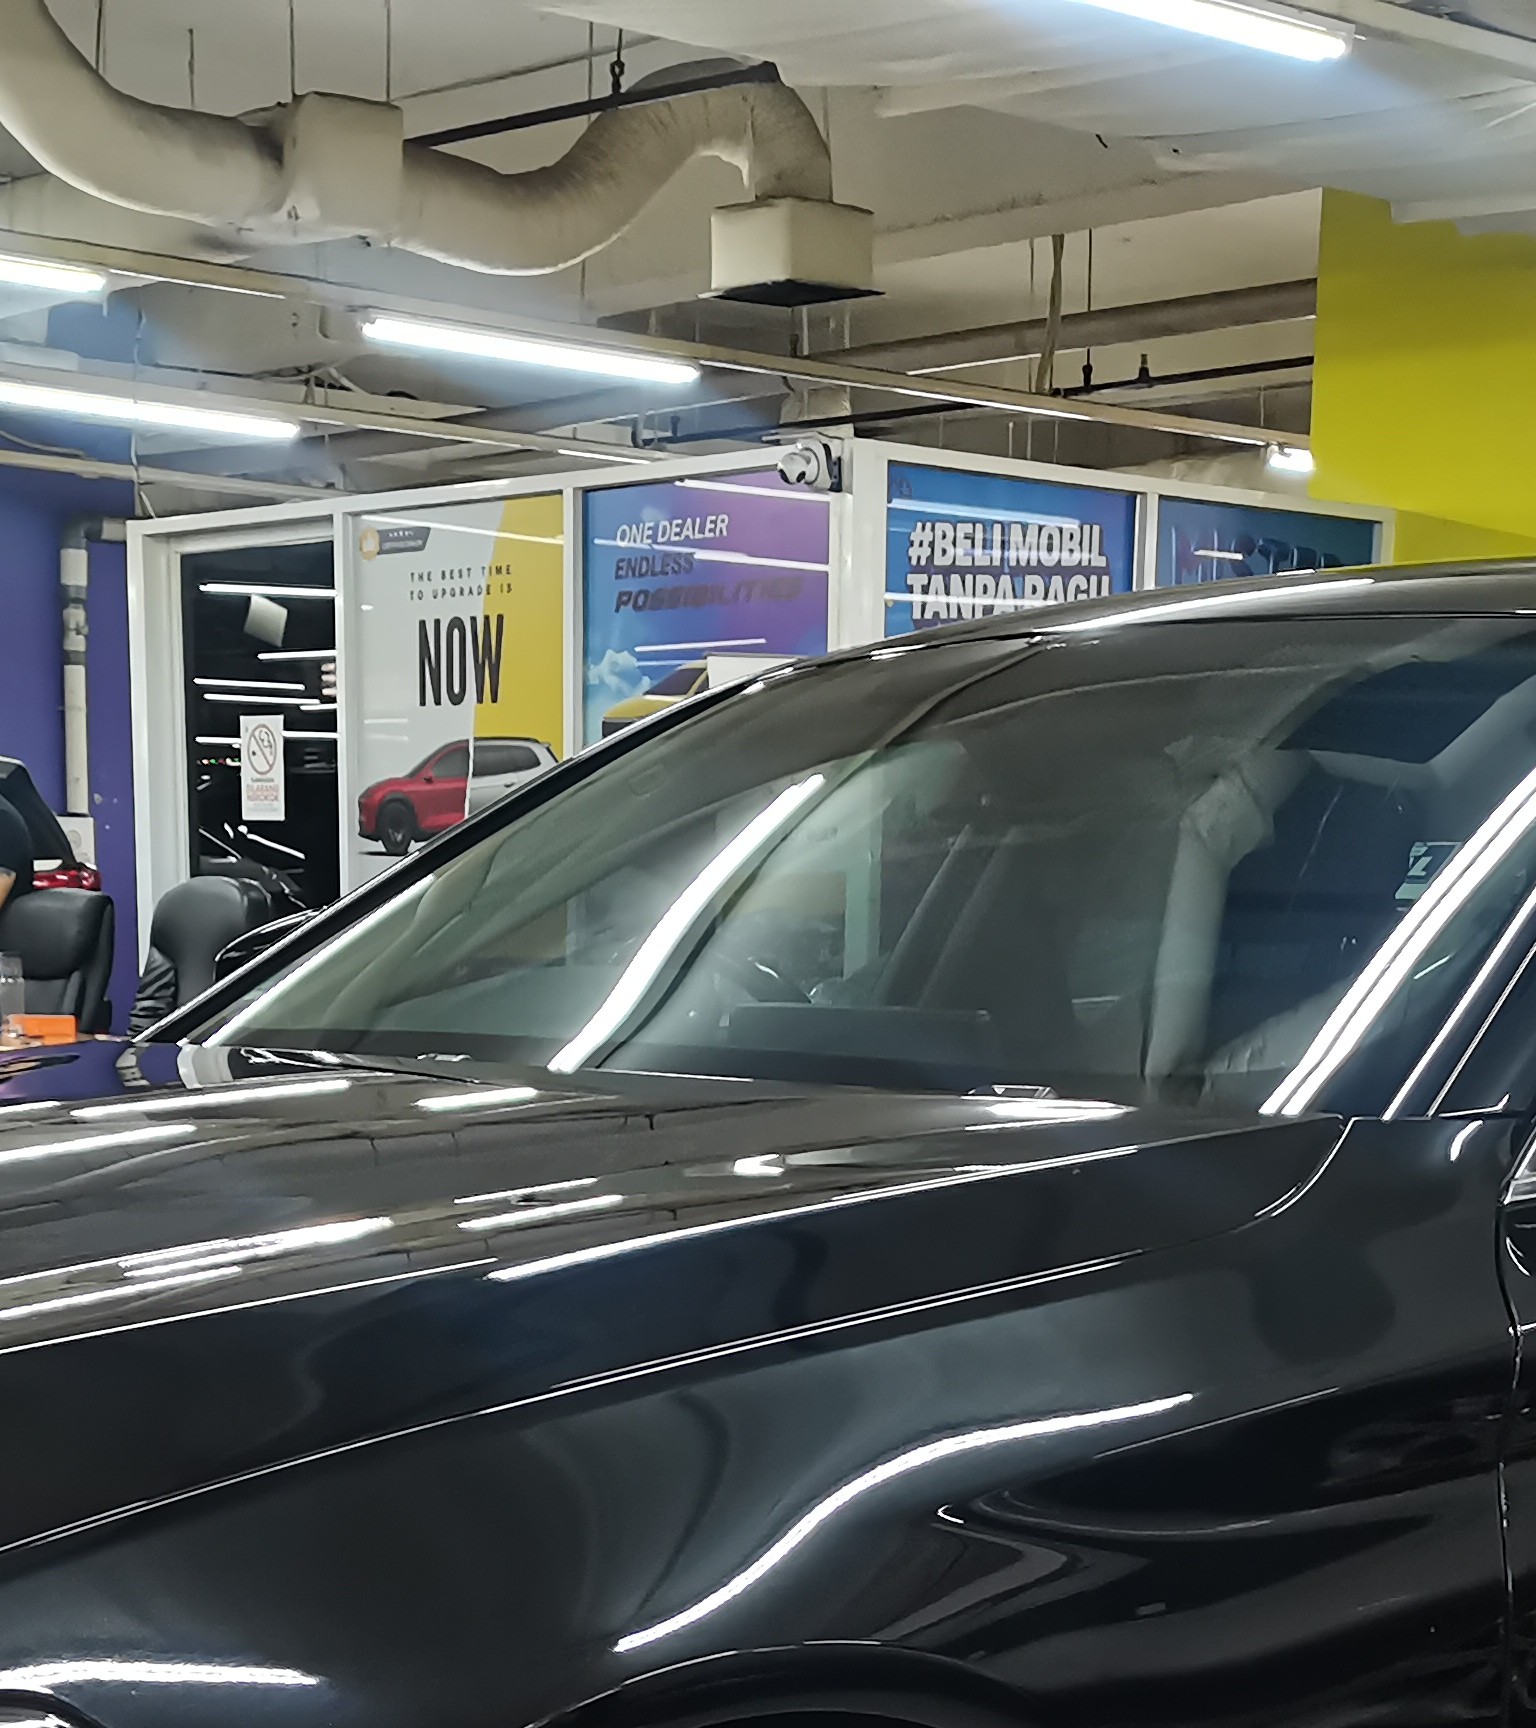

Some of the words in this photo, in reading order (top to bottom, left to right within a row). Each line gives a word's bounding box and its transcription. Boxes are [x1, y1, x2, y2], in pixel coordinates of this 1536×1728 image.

[616, 524, 652, 547] ONE
[657, 514, 729, 543] DEALER
[908, 521, 1002, 567] #BELI
[1009, 524, 1107, 567] MOBIL
[410, 571, 432, 583] THE
[440, 567, 472, 580] BEST
[481, 564, 512, 577] TIME
[615, 552, 695, 580] ENDLESS
[410, 590, 424, 601] TO
[432, 584, 491, 599] UPGRADE
[500, 583, 512, 594] IS
[906, 573, 1018, 620] TANPA
[418, 613, 504, 706] NOW
